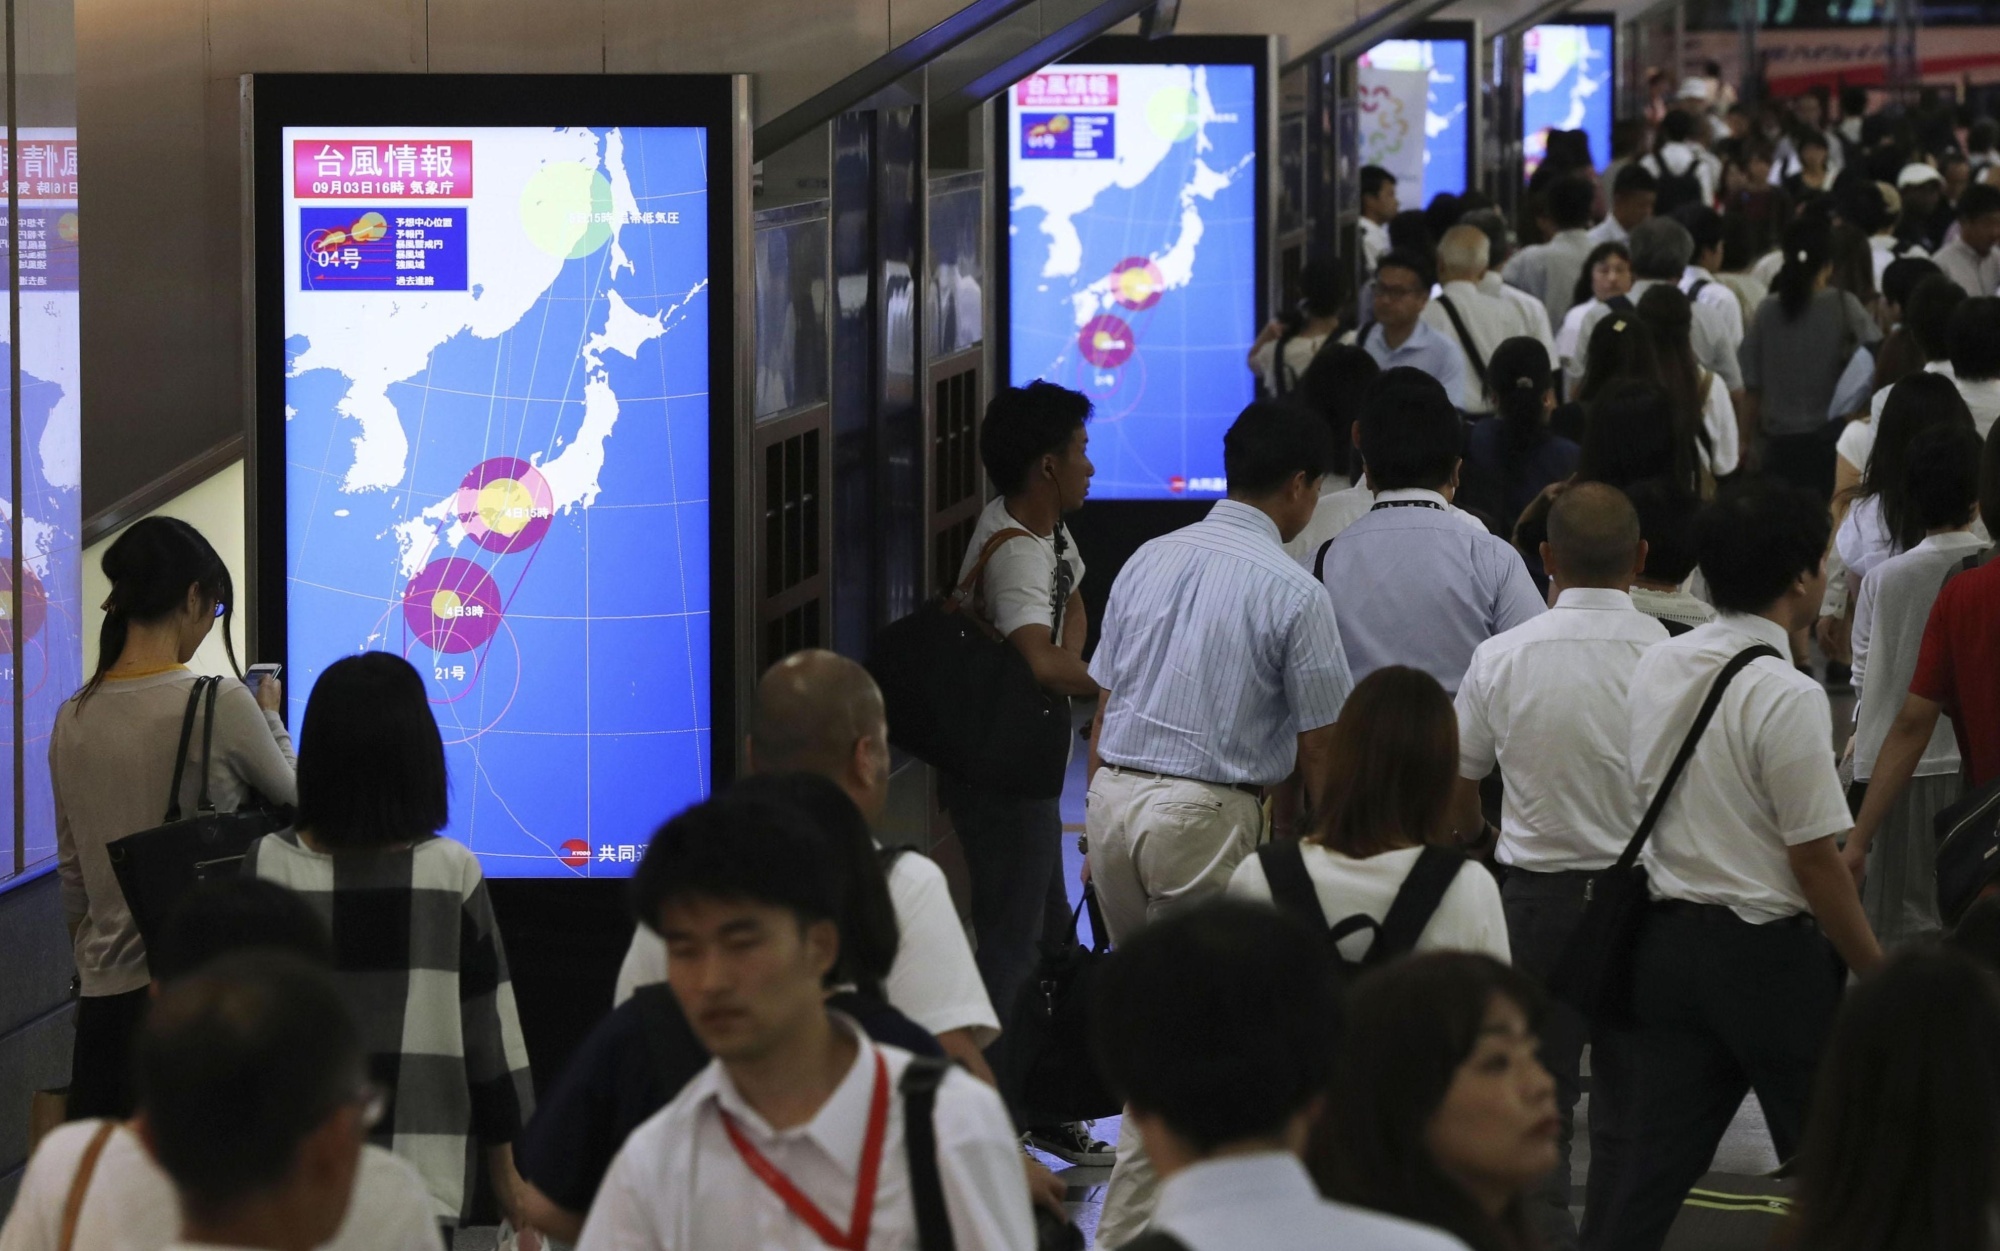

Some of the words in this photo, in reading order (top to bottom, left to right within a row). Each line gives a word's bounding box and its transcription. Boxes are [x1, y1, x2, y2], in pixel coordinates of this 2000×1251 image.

[313, 144, 454, 178] 台風情報
[312, 181, 405, 194] 09月03日16時
[410, 181, 454, 194] 気象庁
[395, 217, 452, 227] 予想中心位置
[395, 229, 424, 238] 予報円
[317, 248, 361, 269] 04号
[395, 259, 425, 269] 強風域
[395, 276, 434, 285] 過去進路
[505, 506, 549, 518] 4日15時
[446, 605, 484, 617] 4日3時
[434, 666, 466, 681] 21号
